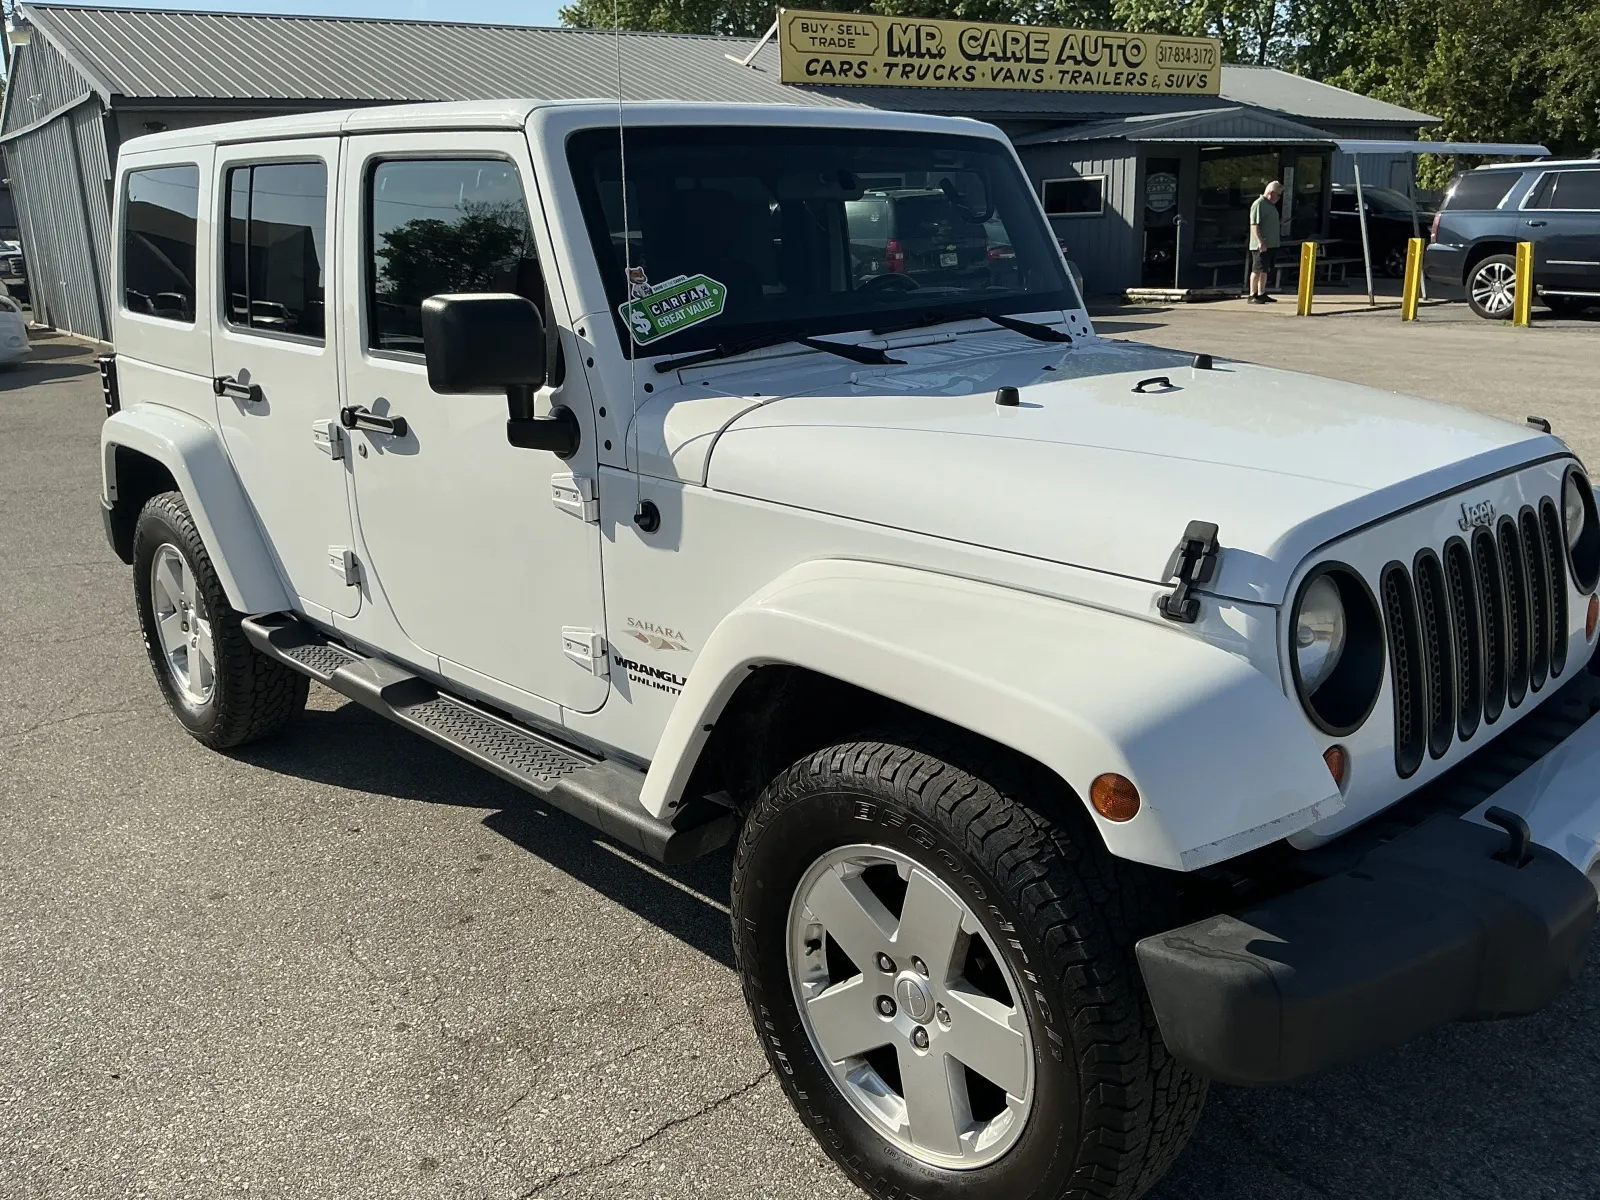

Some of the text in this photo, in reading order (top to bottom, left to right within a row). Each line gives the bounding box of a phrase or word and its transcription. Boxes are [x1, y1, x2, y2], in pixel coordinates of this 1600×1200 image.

[801, 22, 870, 36] BUY SELL
[809, 36, 856, 49] TRADE
[887, 23, 1147, 68] MR. CARE AUTO
[805, 58, 1208, 89] CARS TRUCKS VANS TRAILERS & SUV'S
[651, 288, 708, 315] CARFAX
[657, 298, 716, 328] GREAT VALUE
[1458, 500, 1497, 531] Jeep
[627, 617, 685, 641] SAHARA
